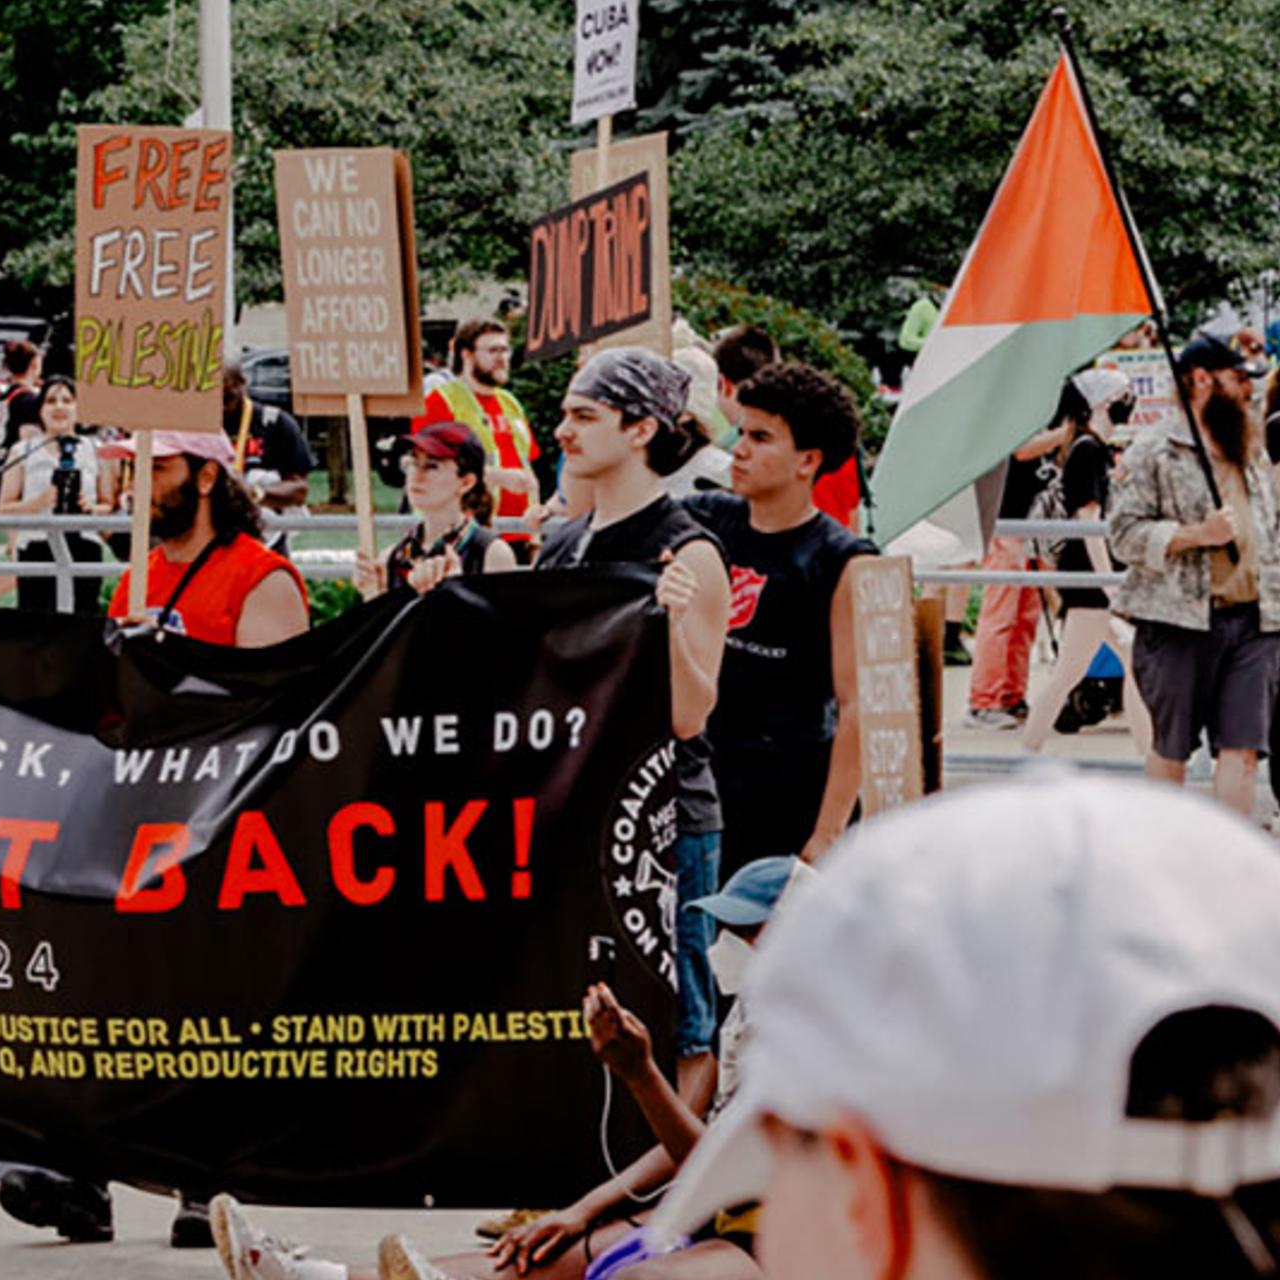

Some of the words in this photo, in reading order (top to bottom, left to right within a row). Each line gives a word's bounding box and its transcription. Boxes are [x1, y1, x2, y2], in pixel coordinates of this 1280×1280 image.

[581, 1, 628, 40] CUBA
[91, 135, 227, 212] FREE
[303, 155, 359, 194] WE
[293, 199, 341, 238] CAN
[347, 197, 381, 236] NO
[90, 226, 218, 303] FREE
[295, 247, 386, 286] LONGER
[300, 294, 389, 335] AFFORD
[75, 307, 225, 393] PALESTINE
[295, 341, 340, 381] THE
[347, 340, 401, 379] RICH
[112, 740, 258, 784] WHAT
[271, 719, 341, 764] DO
[380, 714, 460, 756] WE
[493, 707, 587, 751] DO?
[114, 797, 536, 913] BACK!
[107, 1017, 170, 1047] FOR
[178, 1017, 243, 1046] ALL
[271, 1014, 366, 1044] STAND
[373, 1013, 446, 1043] WITH
[30, 1048, 87, 1079] AND
[94, 1049, 328, 1080] REPRODUCTIVE
[335, 1048, 439, 1078] RIGHTS
